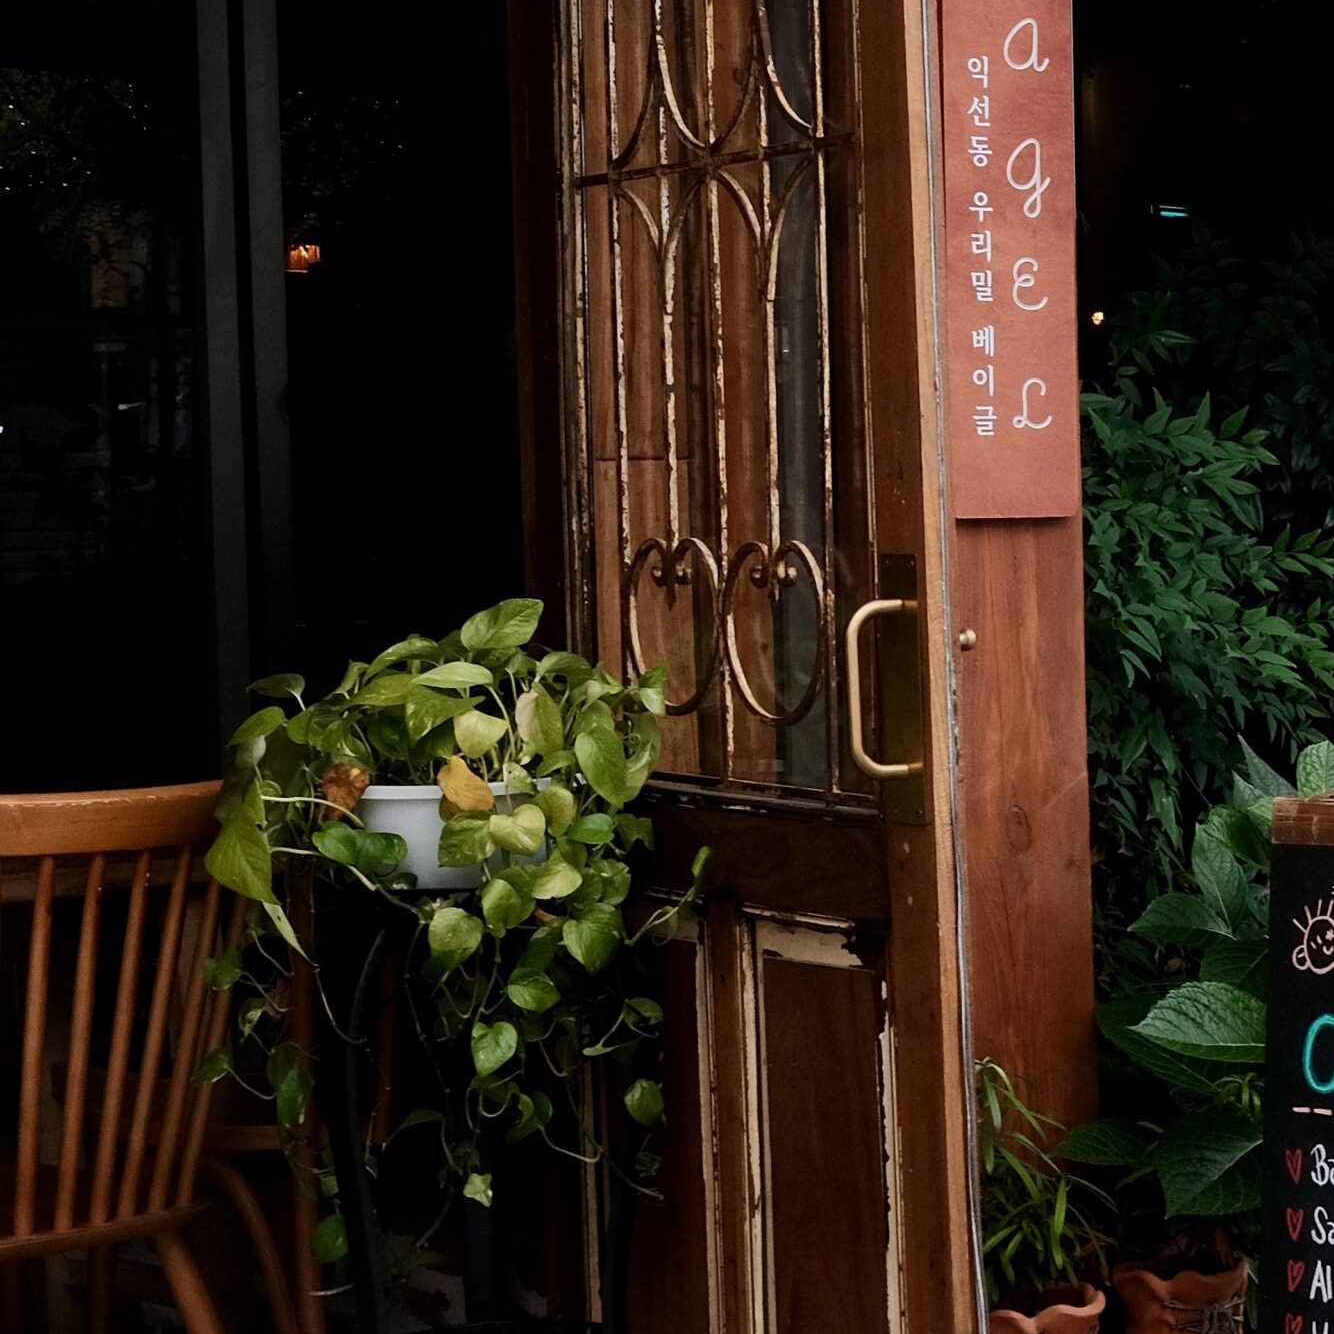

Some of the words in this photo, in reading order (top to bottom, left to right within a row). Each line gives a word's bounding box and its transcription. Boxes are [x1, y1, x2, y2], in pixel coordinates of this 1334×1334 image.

[966, 55, 992, 168] 익선동
[968, 191, 994, 303] 우리밀
[971, 325, 998, 436] 베이글
